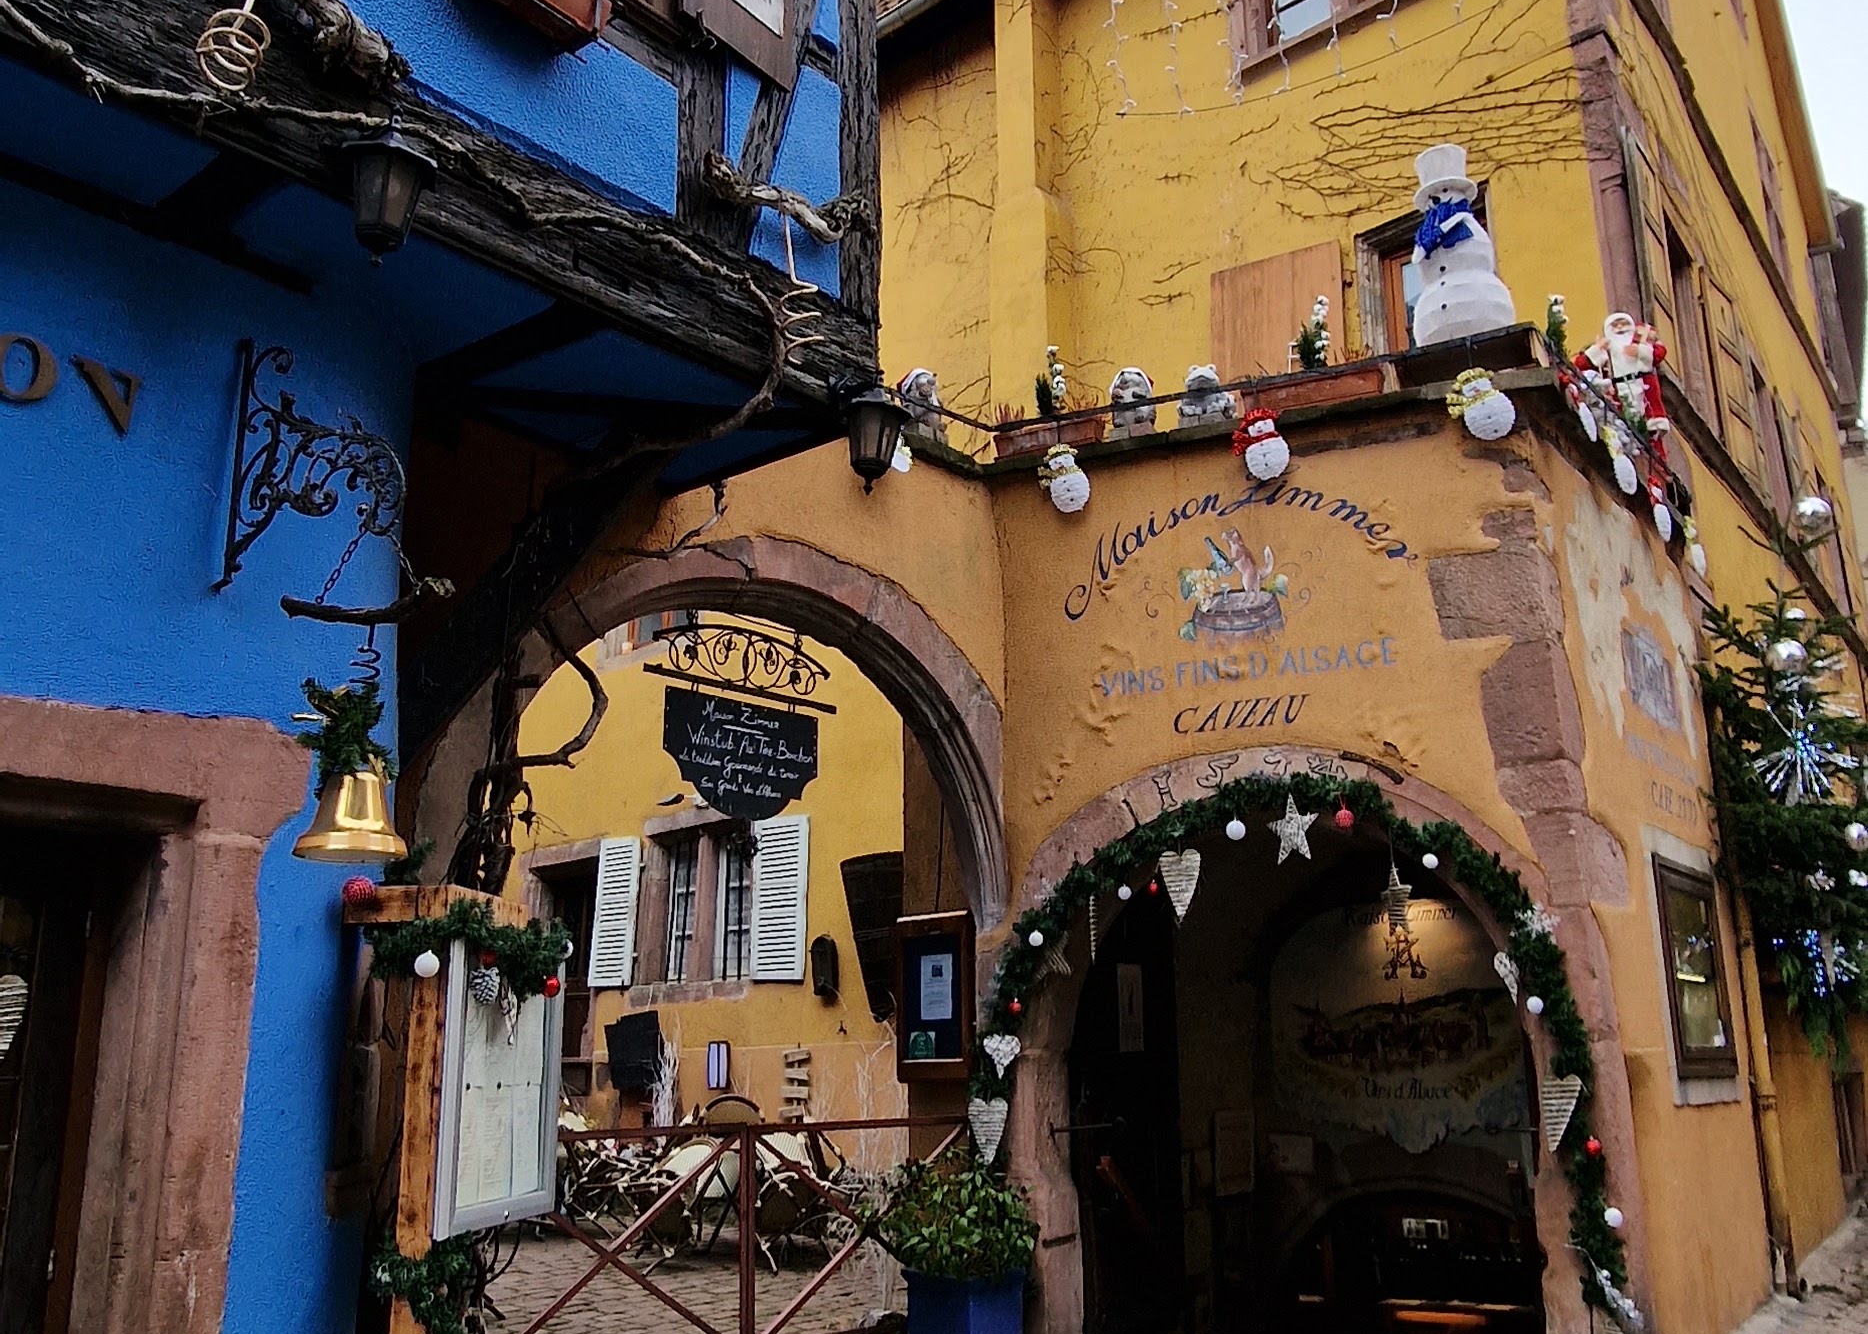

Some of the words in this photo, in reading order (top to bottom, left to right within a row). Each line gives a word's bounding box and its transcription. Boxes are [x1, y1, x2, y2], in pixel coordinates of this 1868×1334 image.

[1064, 490, 1220, 621] Maison
[1217, 466, 1420, 568] Zimmer
[1100, 667, 1165, 699] VINS
[1174, 655, 1241, 689] FINS
[1248, 636, 1400, 681] D'ALSACE
[1173, 692, 1311, 736] CAVEAU
